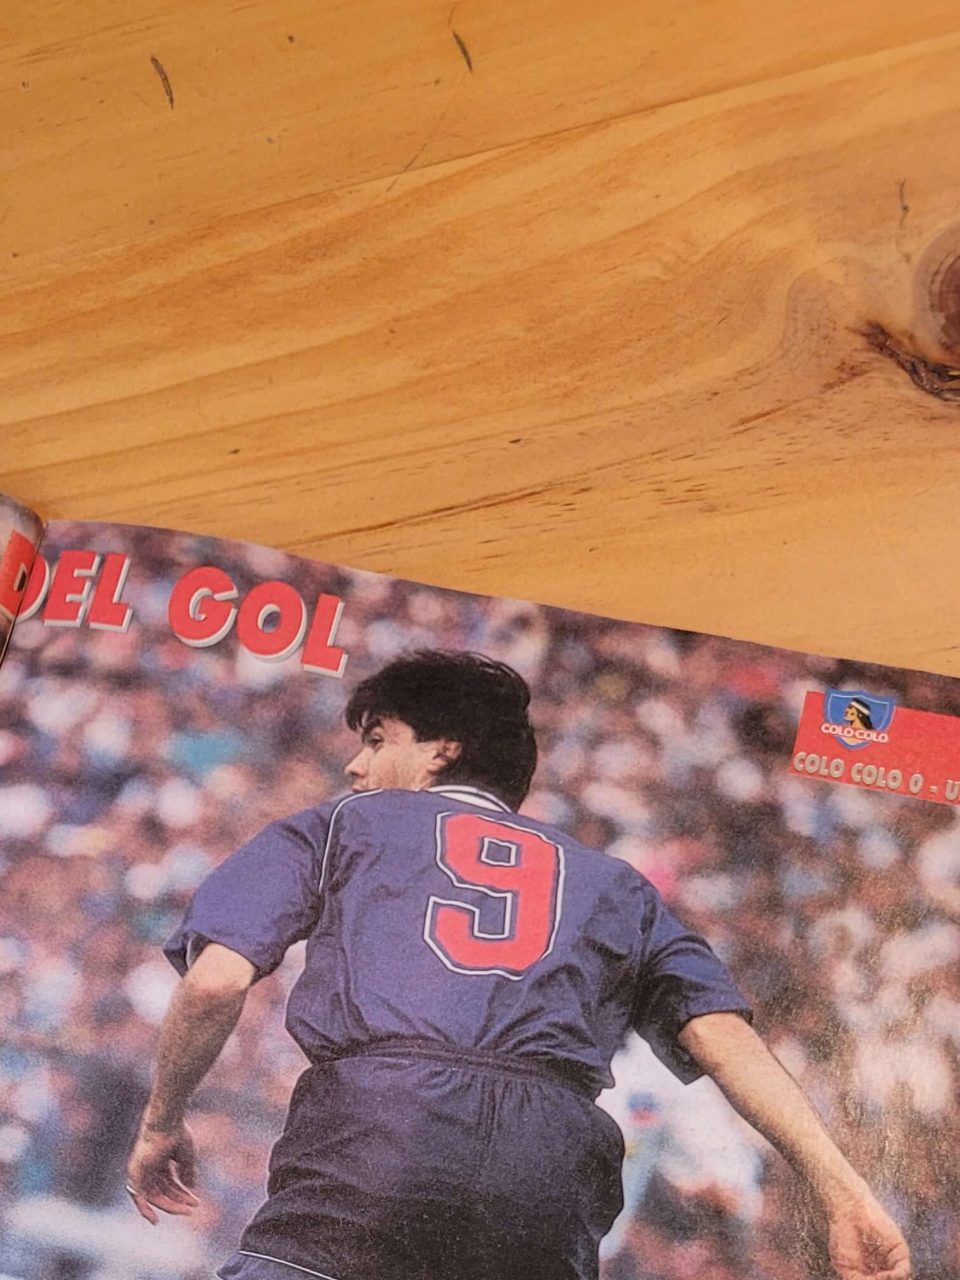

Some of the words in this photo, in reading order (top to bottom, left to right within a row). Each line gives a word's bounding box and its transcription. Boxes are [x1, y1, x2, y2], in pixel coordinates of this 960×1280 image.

[168, 566, 349, 678] GOL
[793, 752, 845, 779] COLO
[851, 762, 903, 790] COLO
[424, 811, 566, 980] 9
